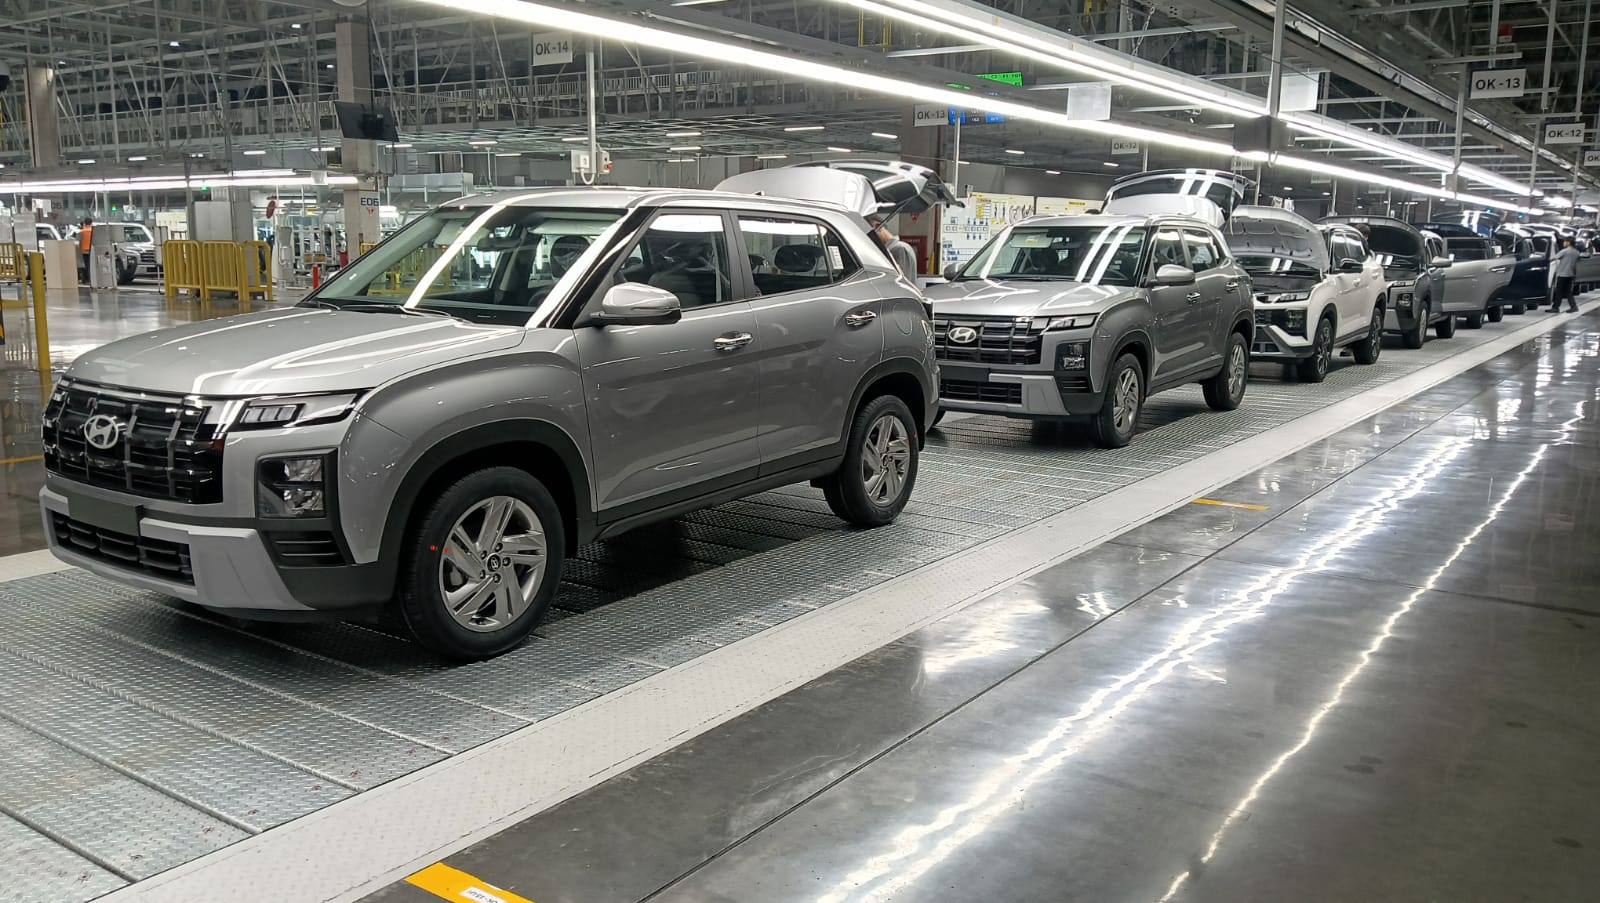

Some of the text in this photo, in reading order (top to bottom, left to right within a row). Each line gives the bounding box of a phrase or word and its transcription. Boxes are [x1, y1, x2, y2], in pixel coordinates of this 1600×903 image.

[535, 41, 569, 56] OK-14
[1475, 77, 1521, 90] OK-13
[917, 111, 946, 121] OK-13
[1548, 129, 1582, 138] OK-12
